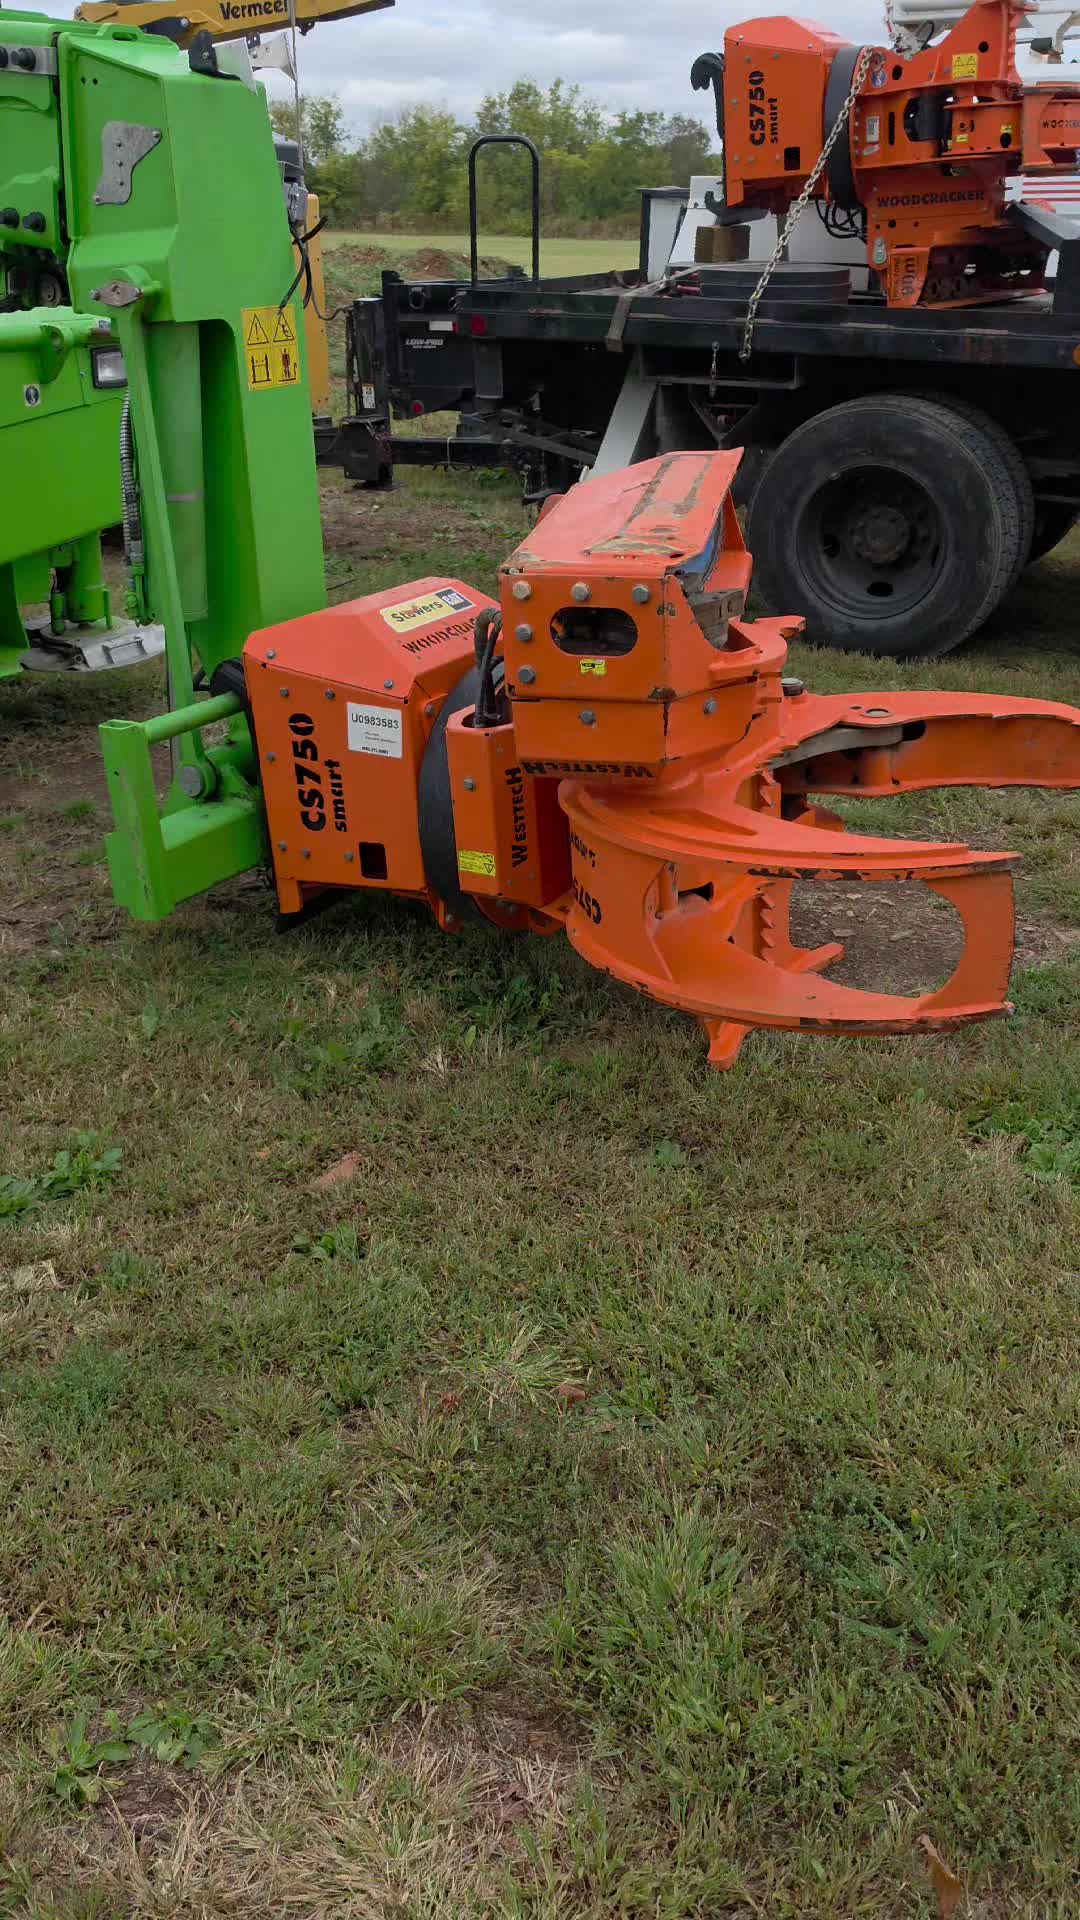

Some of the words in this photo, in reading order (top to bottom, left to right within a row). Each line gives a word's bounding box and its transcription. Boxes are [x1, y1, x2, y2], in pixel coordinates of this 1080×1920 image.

[748, 71, 766, 146] CS750
[768, 98, 778, 144] smart
[878, 191, 985, 208] WOODCRACKER
[391, 601, 444, 623] Stowers
[351, 712, 400, 729] U0983583
[288, 712, 328, 832] CS750
[324, 759, 348, 833] smart
